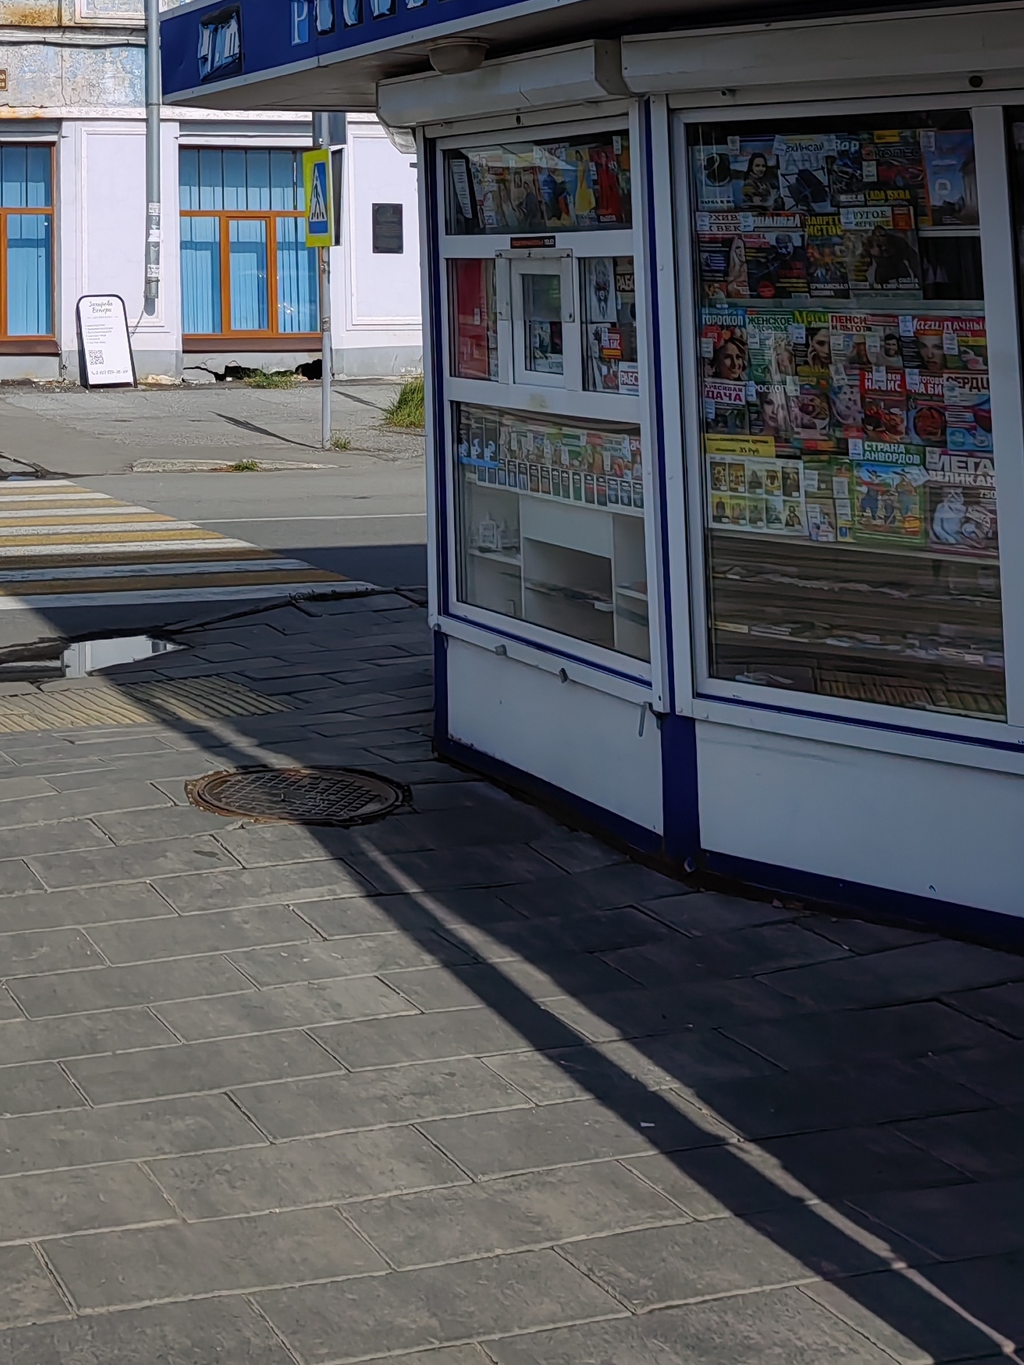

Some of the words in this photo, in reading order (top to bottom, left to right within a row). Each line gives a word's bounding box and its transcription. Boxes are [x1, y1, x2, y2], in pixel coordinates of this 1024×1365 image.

[702, 314, 744, 326] ГОРОСКОП
[747, 316, 793, 326] ЖЕНСКОЕ
[705, 390, 743, 403] ДАЧА
[864, 442, 906, 453] СТРАНА
[863, 452, 921, 465] АНВОРДОВ
